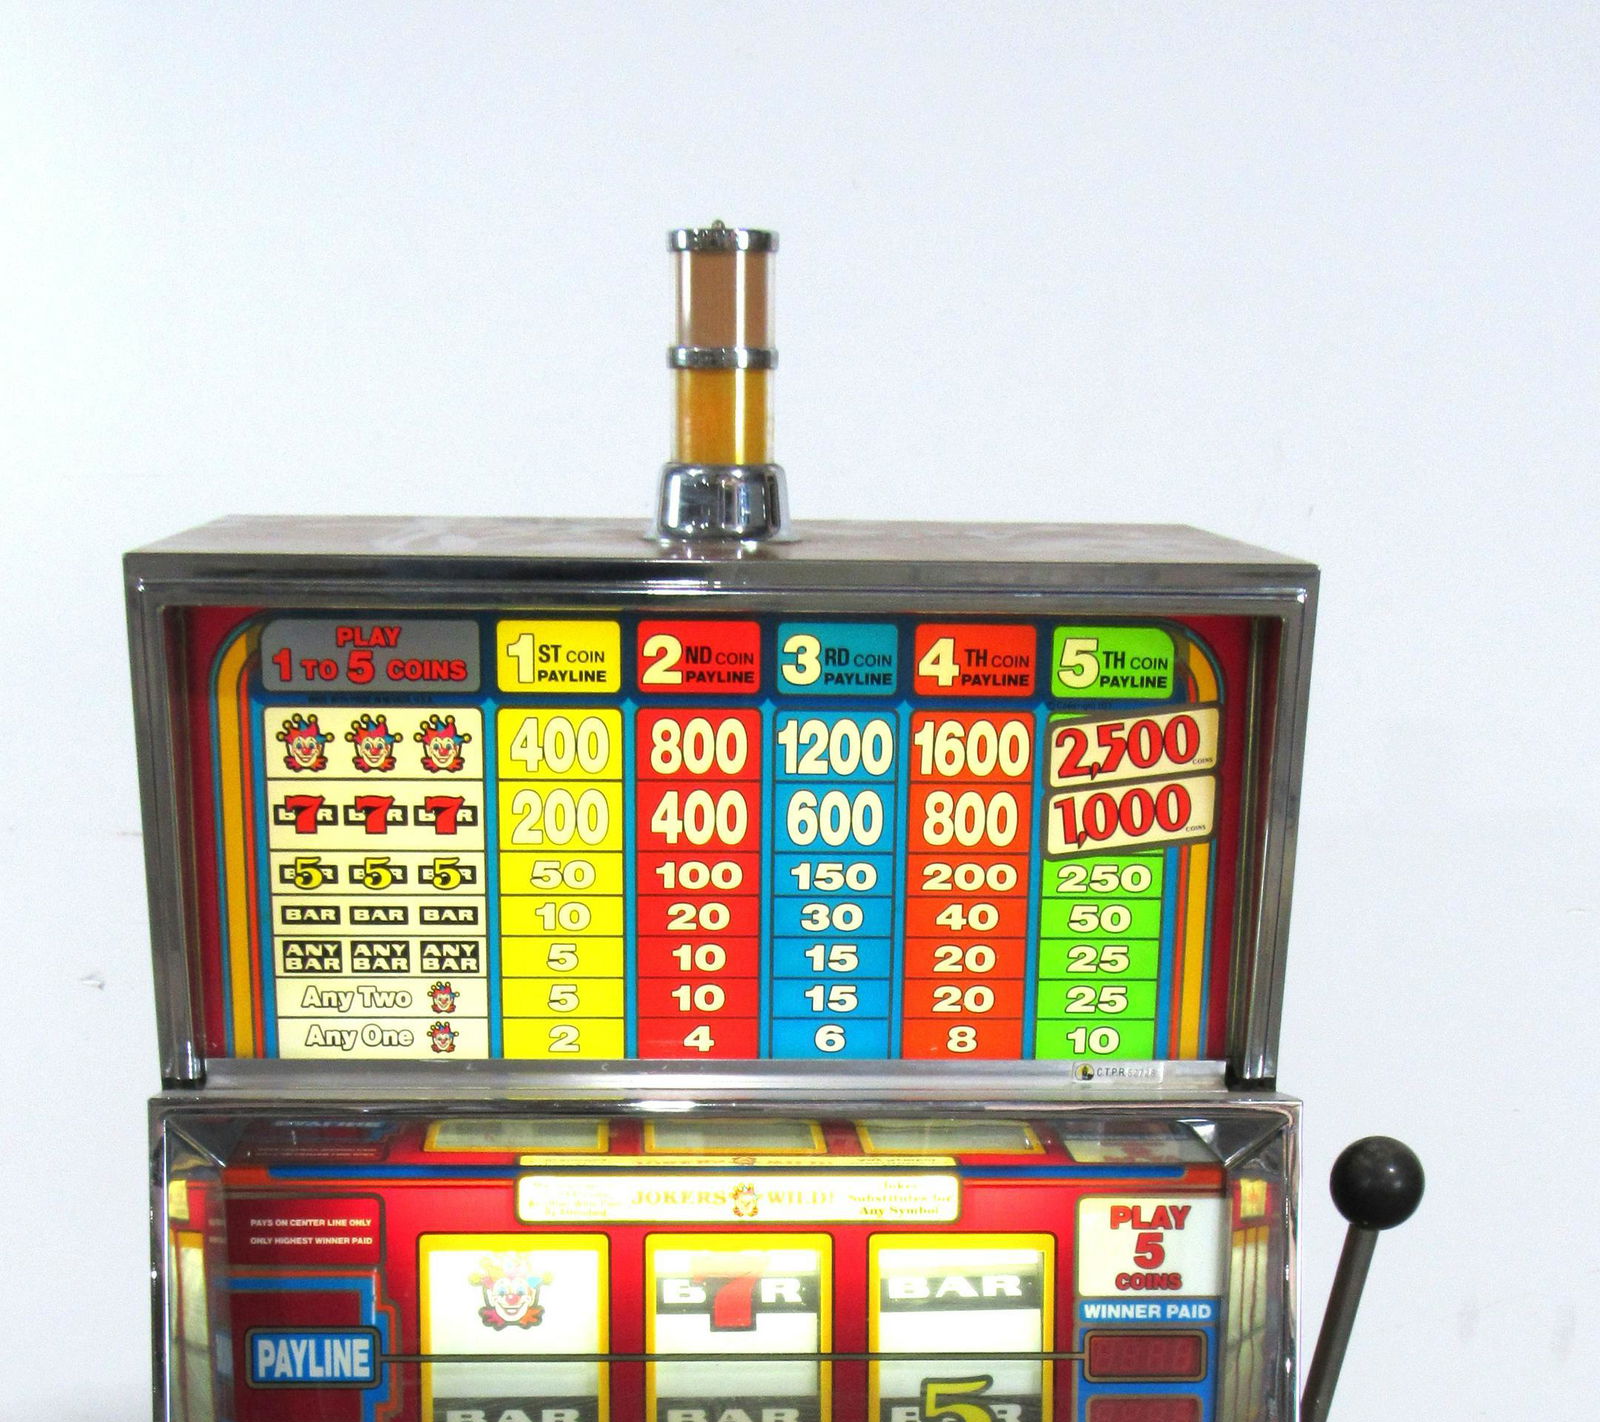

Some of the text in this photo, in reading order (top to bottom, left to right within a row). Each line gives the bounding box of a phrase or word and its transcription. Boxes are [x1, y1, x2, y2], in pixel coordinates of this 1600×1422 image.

[336, 625, 402, 647] PLAY
[272, 648, 468, 684] 1 TO 5 COINS
[566, 650, 605, 664] COIN
[715, 652, 754, 665] COIN
[853, 653, 892, 666] COIN
[991, 655, 1029, 668] COIN
[1130, 657, 1168, 670] COIN
[538, 670, 607, 683] PAYLINE
[685, 671, 755, 684] PAYLINE
[824, 672, 892, 685] PAYLINE
[961, 673, 1029, 687] PAYLINE
[1100, 675, 1167, 689] PAYLINE
[510, 716, 610, 773] 400
[650, 717, 748, 774] 800
[777, 718, 894, 776] 1200
[913, 719, 1031, 777] 1600
[1055, 714, 1200, 780] 2,500
[284, 795, 465, 835] 7 7 7
[511, 788, 610, 846] 200
[650, 789, 748, 845] 400
[786, 789, 884, 847] 600
[922, 790, 1018, 848] 800
[1054, 783, 1192, 849] 1,000
[294, 856, 461, 890] 5 5 5
[530, 861, 1152, 893] 50 100 150 200 250
[285, 908, 474, 921] BAR BAR BAR
[535, 903, 1132, 933] 10 20 30 40 50
[286, 944, 476, 956] ANY ANY ANY
[547, 944, 1131, 973] 5 10 15 20 25
[286, 957, 478, 971] BAR BAR BAR
[301, 985, 413, 1012] Any Two
[548, 984, 1129, 1013] 5 10 15 20 25
[304, 1023, 415, 1051] Any One
[548, 1025, 1120, 1054] 2 4 6 8 10
[631, 1191, 727, 1205] JOKERS
[250, 1219, 371, 1227] PAYS ON CENTER LINE ONLY
[1110, 1205, 1192, 1230] PLAY
[250, 1237, 373, 1245] ONLY HIGHEST WINNER PAID
[1133, 1232, 1166, 1270] 5
[888, 1274, 1022, 1299] BAR
[1115, 1272, 1183, 1290] COINS
[1084, 1303, 1212, 1319] WINNER PAID
[257, 1338, 371, 1381] PAYLINE
